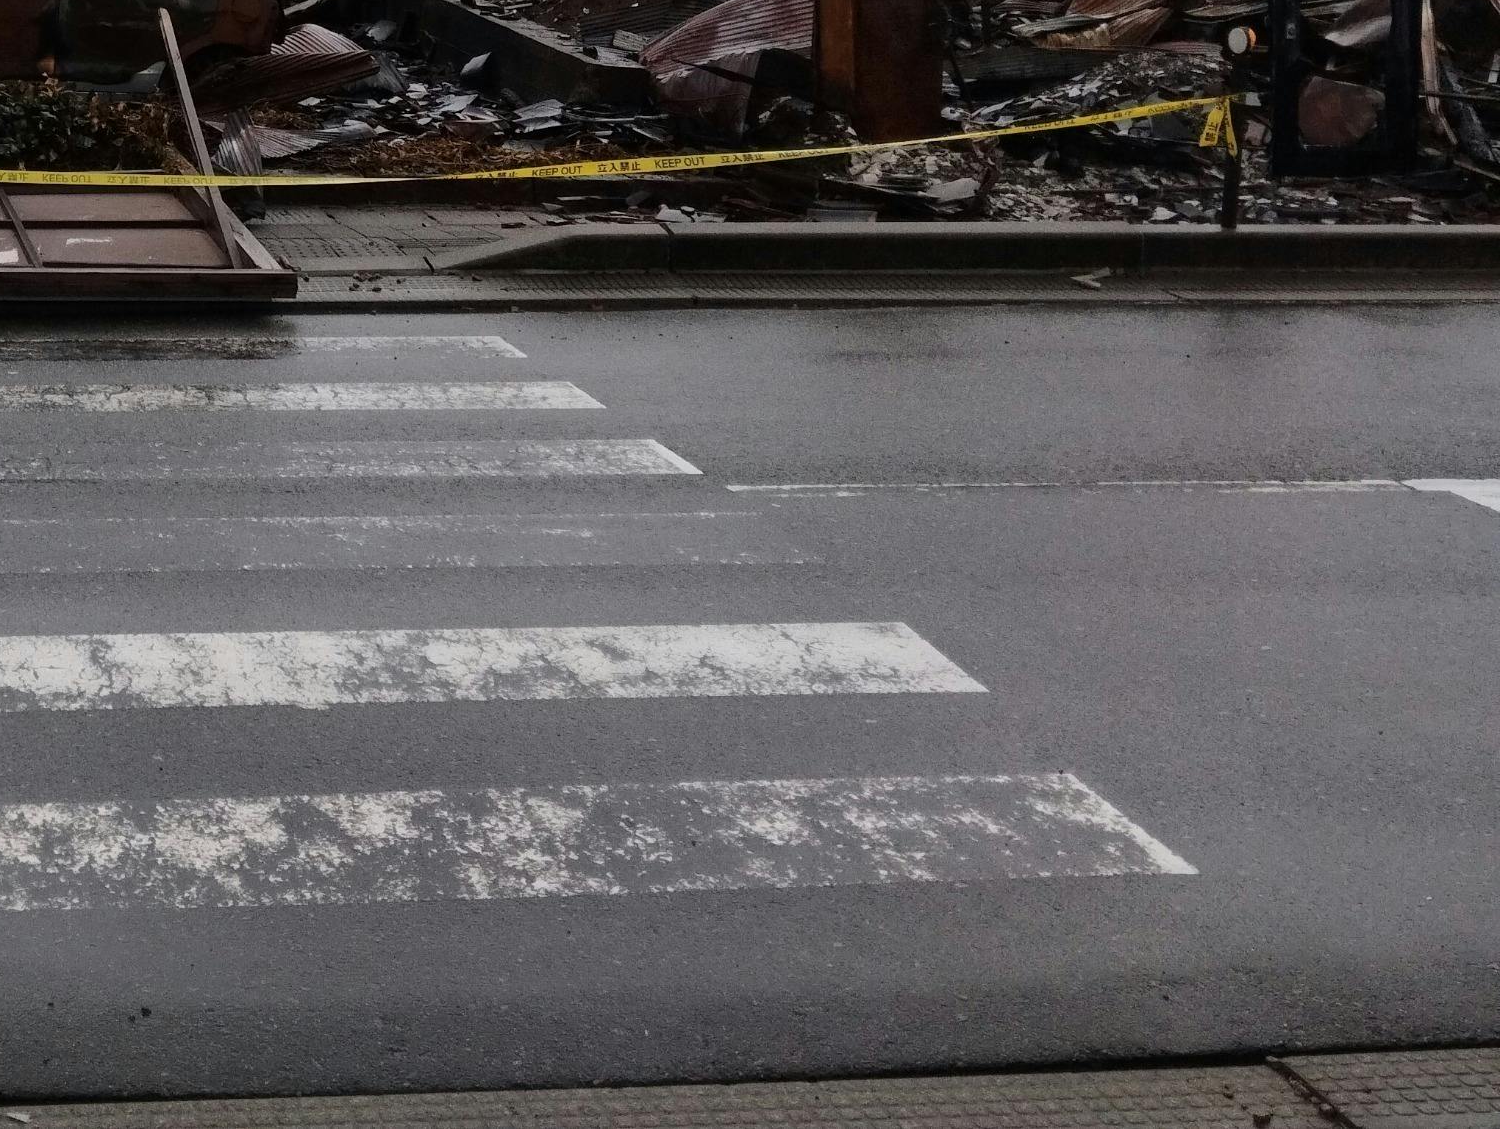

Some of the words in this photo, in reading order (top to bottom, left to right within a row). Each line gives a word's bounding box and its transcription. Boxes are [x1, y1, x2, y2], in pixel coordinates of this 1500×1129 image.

[532, 166, 559, 177] KEEP
[561, 165, 583, 175] OUT
[597, 161, 641, 173] 立入禁止
[654, 158, 682, 169] KEEP
[683, 156, 706, 167] OUT
[720, 153, 765, 164] 立入禁止
